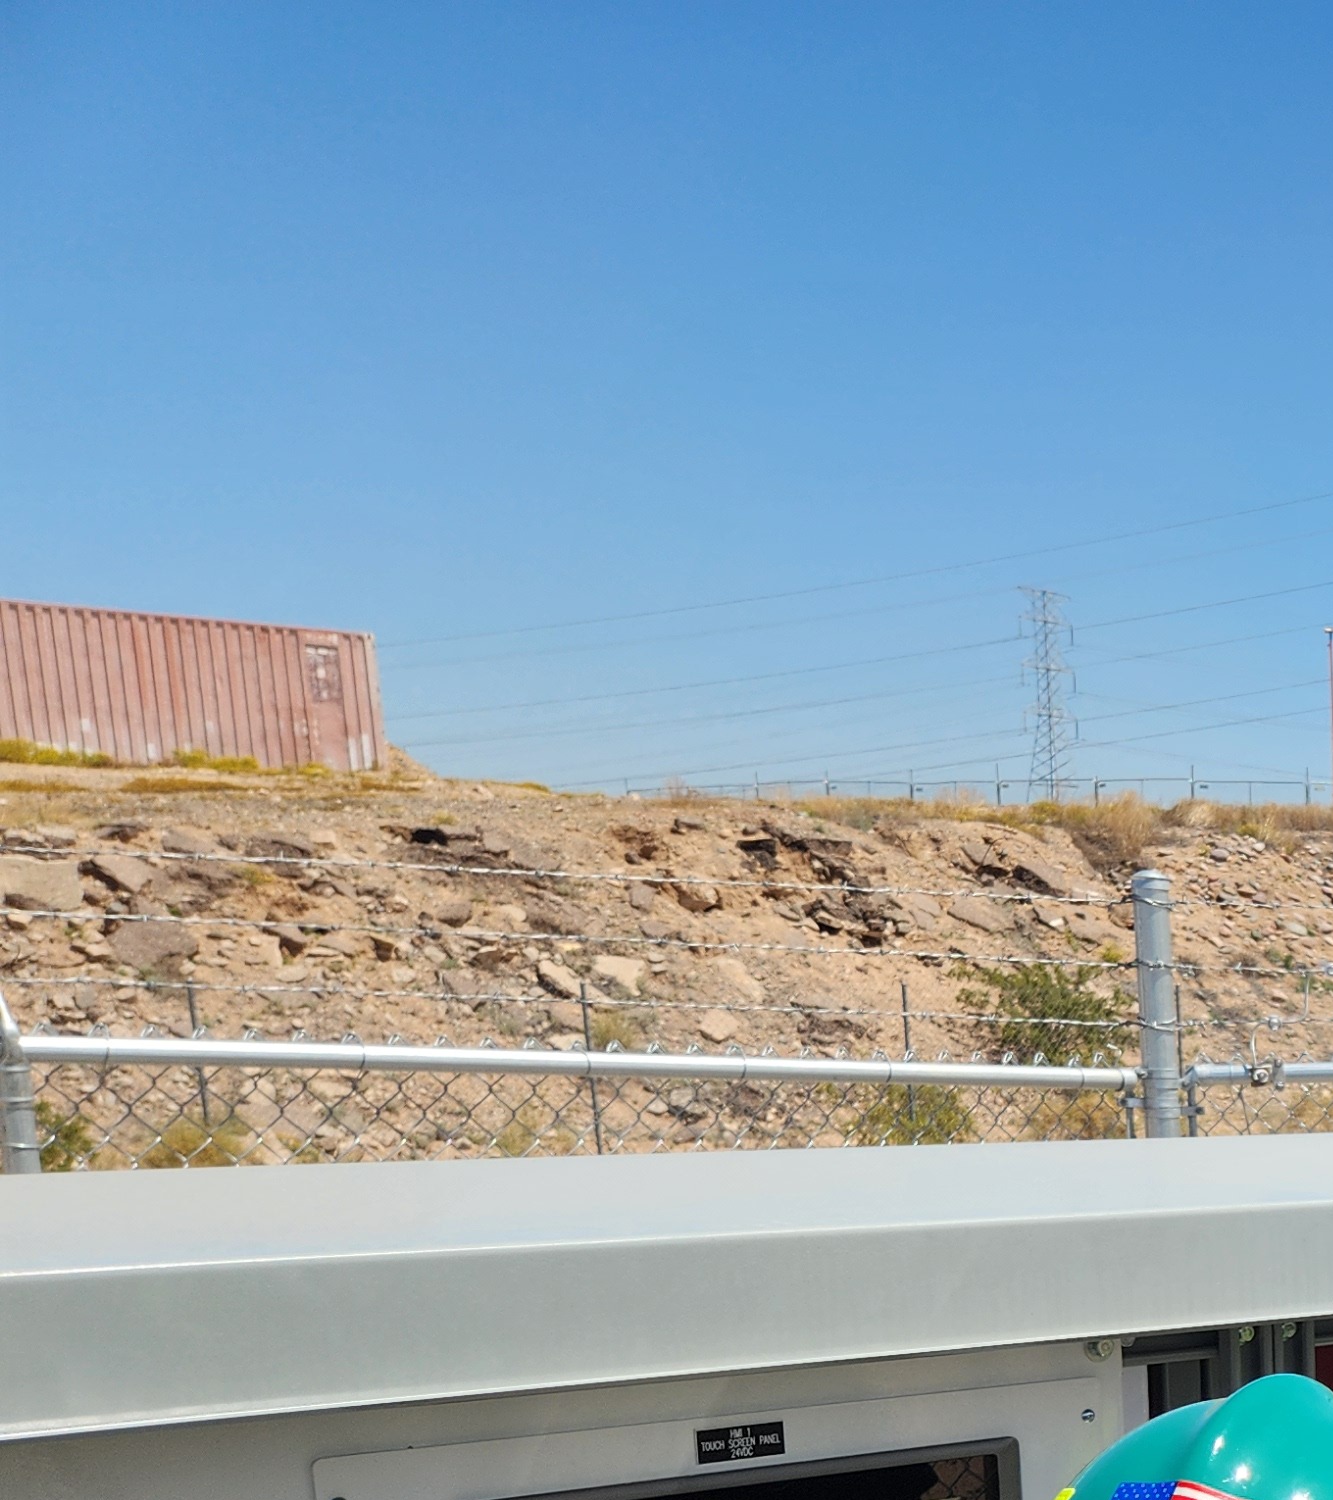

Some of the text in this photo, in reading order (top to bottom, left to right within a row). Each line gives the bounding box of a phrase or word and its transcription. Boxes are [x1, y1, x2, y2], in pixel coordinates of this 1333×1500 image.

[746, 1427, 751, 1437] 1
[700, 1433, 781, 1452] TOUCH SCREEN PANEL
